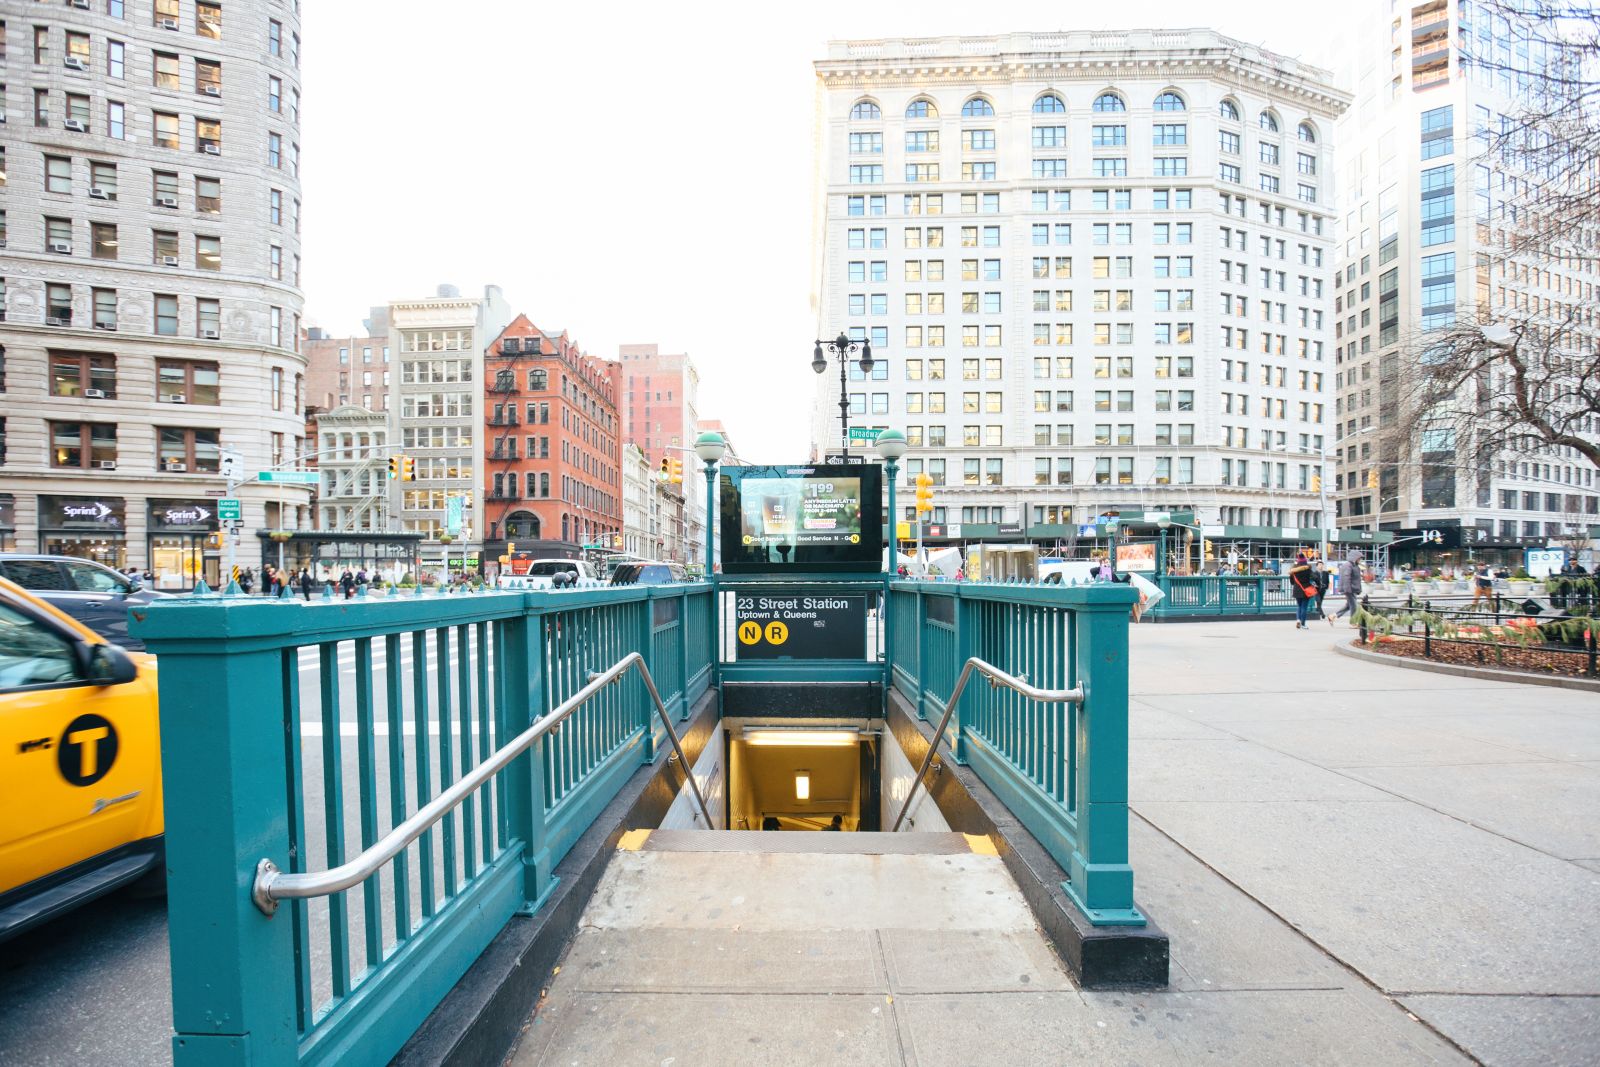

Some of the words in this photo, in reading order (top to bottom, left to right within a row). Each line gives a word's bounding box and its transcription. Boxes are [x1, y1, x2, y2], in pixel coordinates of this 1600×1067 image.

[851, 429, 880, 438] Broadwa
[64, 506, 98, 517] Sprint
[166, 509, 197, 520] Sprint
[1531, 553, 1561, 561] BOX
[738, 598, 754, 609] 23
[759, 598, 798, 609] Street
[803, 598, 848, 609] Station
[738, 611, 770, 620] Uptown
[773, 610, 780, 619] &
[783, 610, 817, 619] Queens
